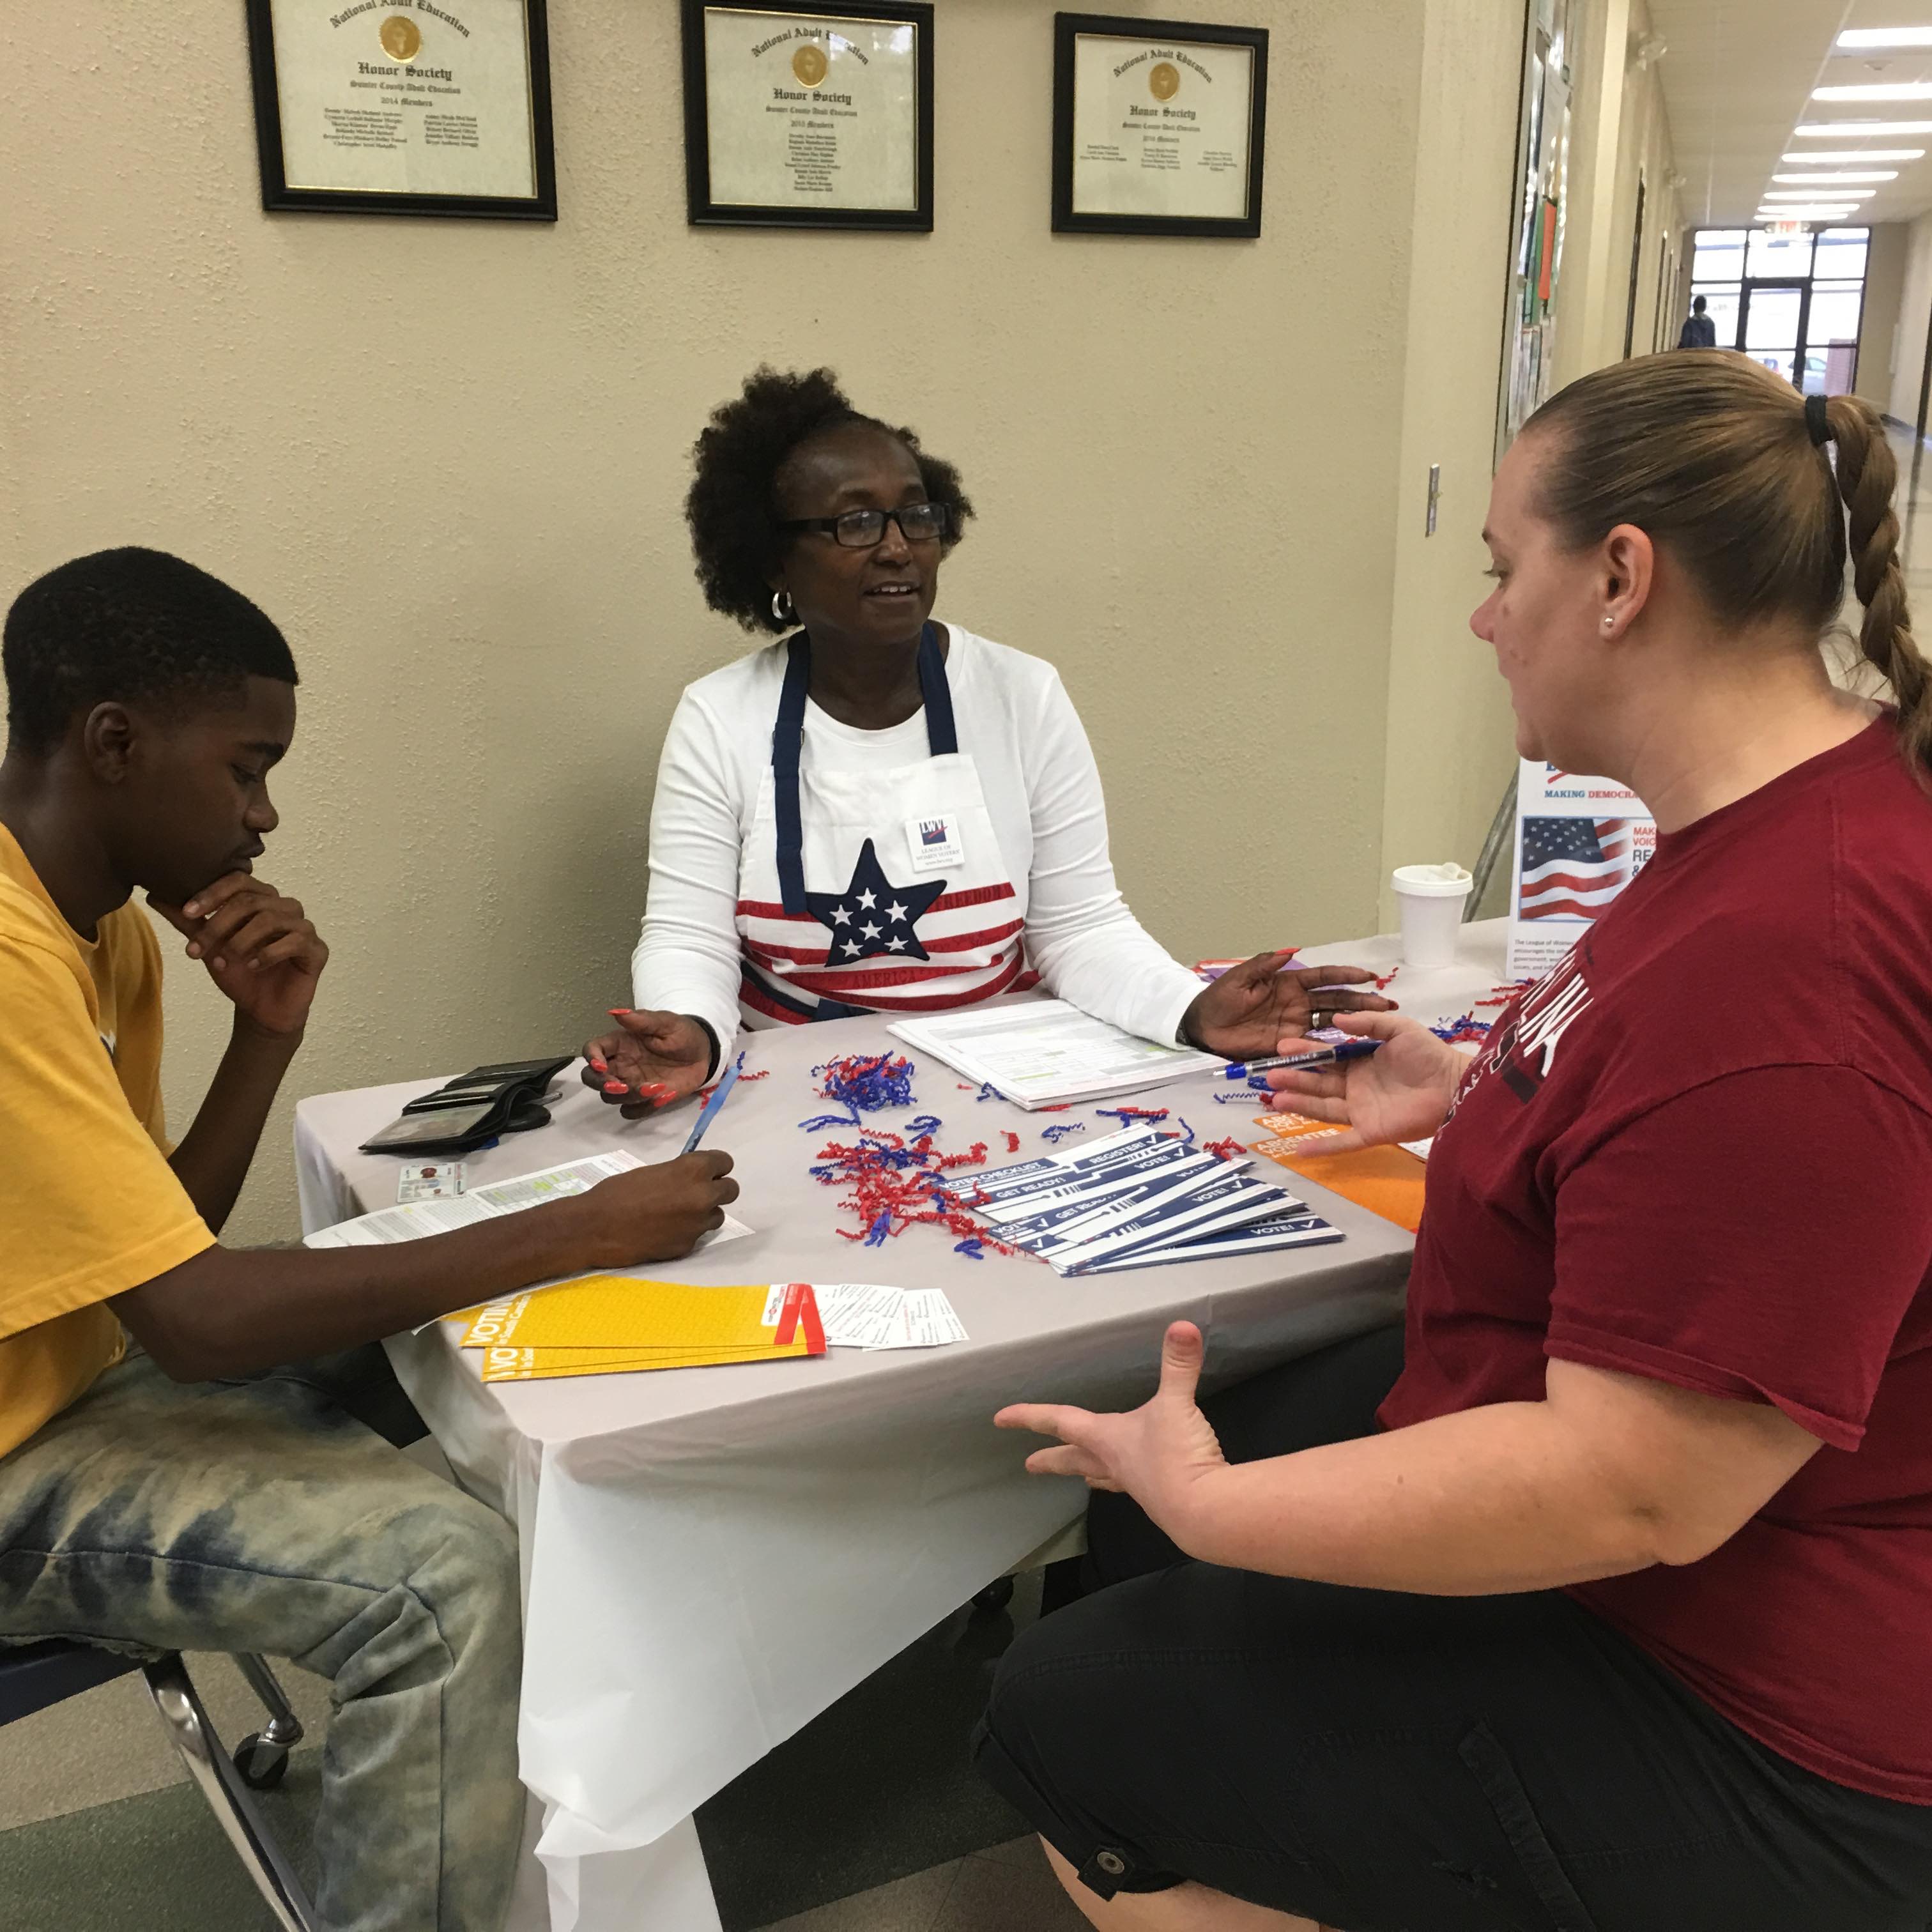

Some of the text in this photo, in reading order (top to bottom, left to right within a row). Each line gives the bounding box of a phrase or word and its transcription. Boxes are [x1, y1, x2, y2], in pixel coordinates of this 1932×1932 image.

[330, 0, 377, 28] National
[417, 0, 470, 38] Education
[751, 29, 792, 57] National
[794, 27, 822, 38] Adult
[358, 62, 452, 81] Honor Society
[1113, 49, 1212, 83] National Adult Education
[774, 88, 852, 105] Honor Society
[1130, 105, 1196, 121] Honor Society
[1632, 865, 1639, 877] &
[1089, 1141, 1146, 1164] REGISTER!
[1135, 1155, 1170, 1169] VOTE!
[939, 1162, 1043, 1189] VOTER CHECKLIST
[996, 1177, 1066, 1198] GET READY!
[1192, 1188, 1229, 1203] VOTE!
[1055, 1207, 1078, 1218] GET
[1250, 1223, 1295, 1235] VOTE!
